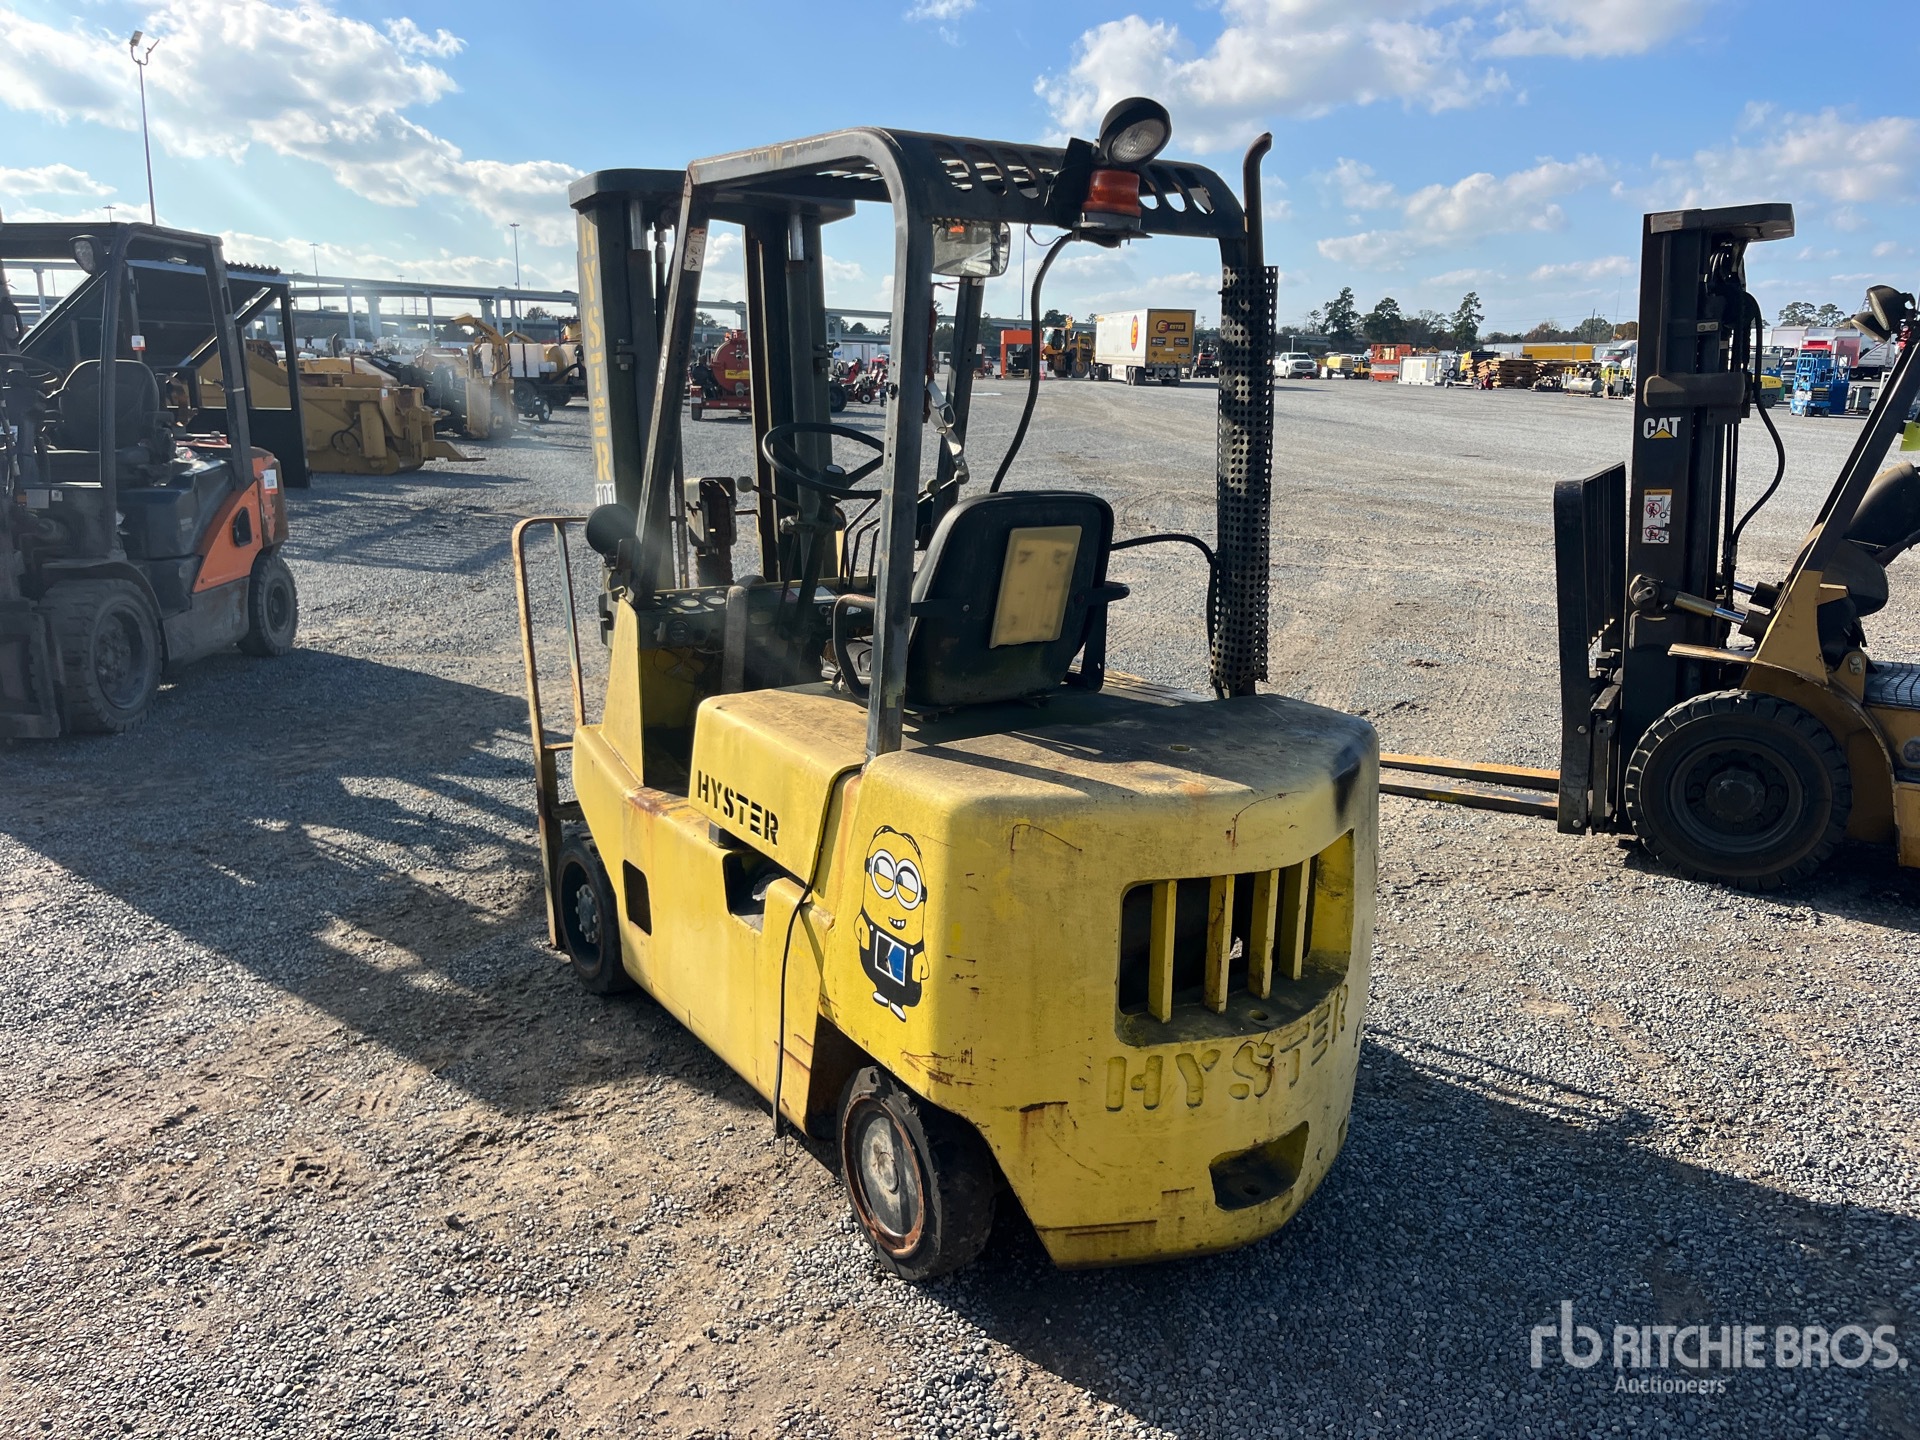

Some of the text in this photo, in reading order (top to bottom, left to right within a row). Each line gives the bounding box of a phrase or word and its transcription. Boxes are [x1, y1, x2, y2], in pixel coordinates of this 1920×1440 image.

[581, 216, 612, 481] HYSTER
[1643, 416, 1682, 439] CAT
[697, 769, 780, 847] HYSTER
[1104, 983, 1350, 1112] HYSTER
